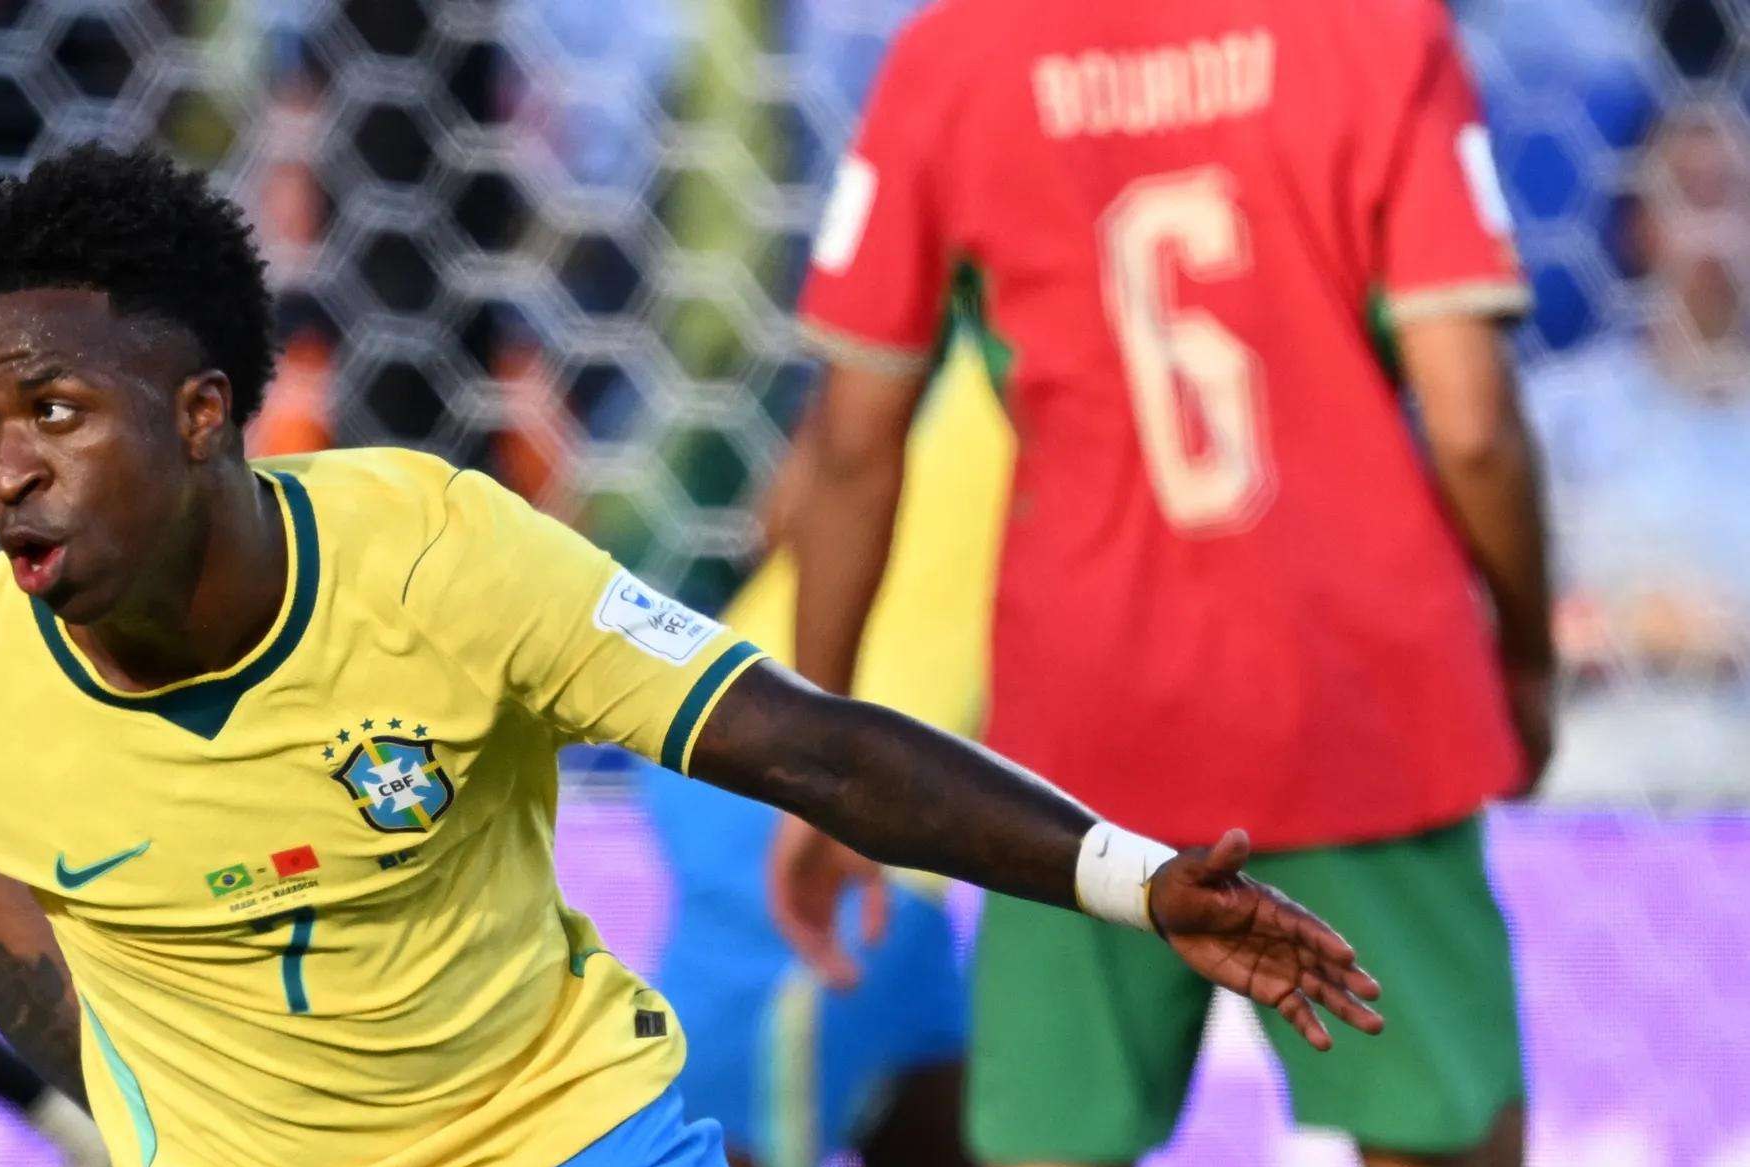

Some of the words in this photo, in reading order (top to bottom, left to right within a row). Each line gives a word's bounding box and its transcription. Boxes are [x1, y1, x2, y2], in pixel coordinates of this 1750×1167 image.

[1096, 165, 1278, 537] 6
[378, 774, 415, 797] CBF
[251, 905, 316, 1014] 7
